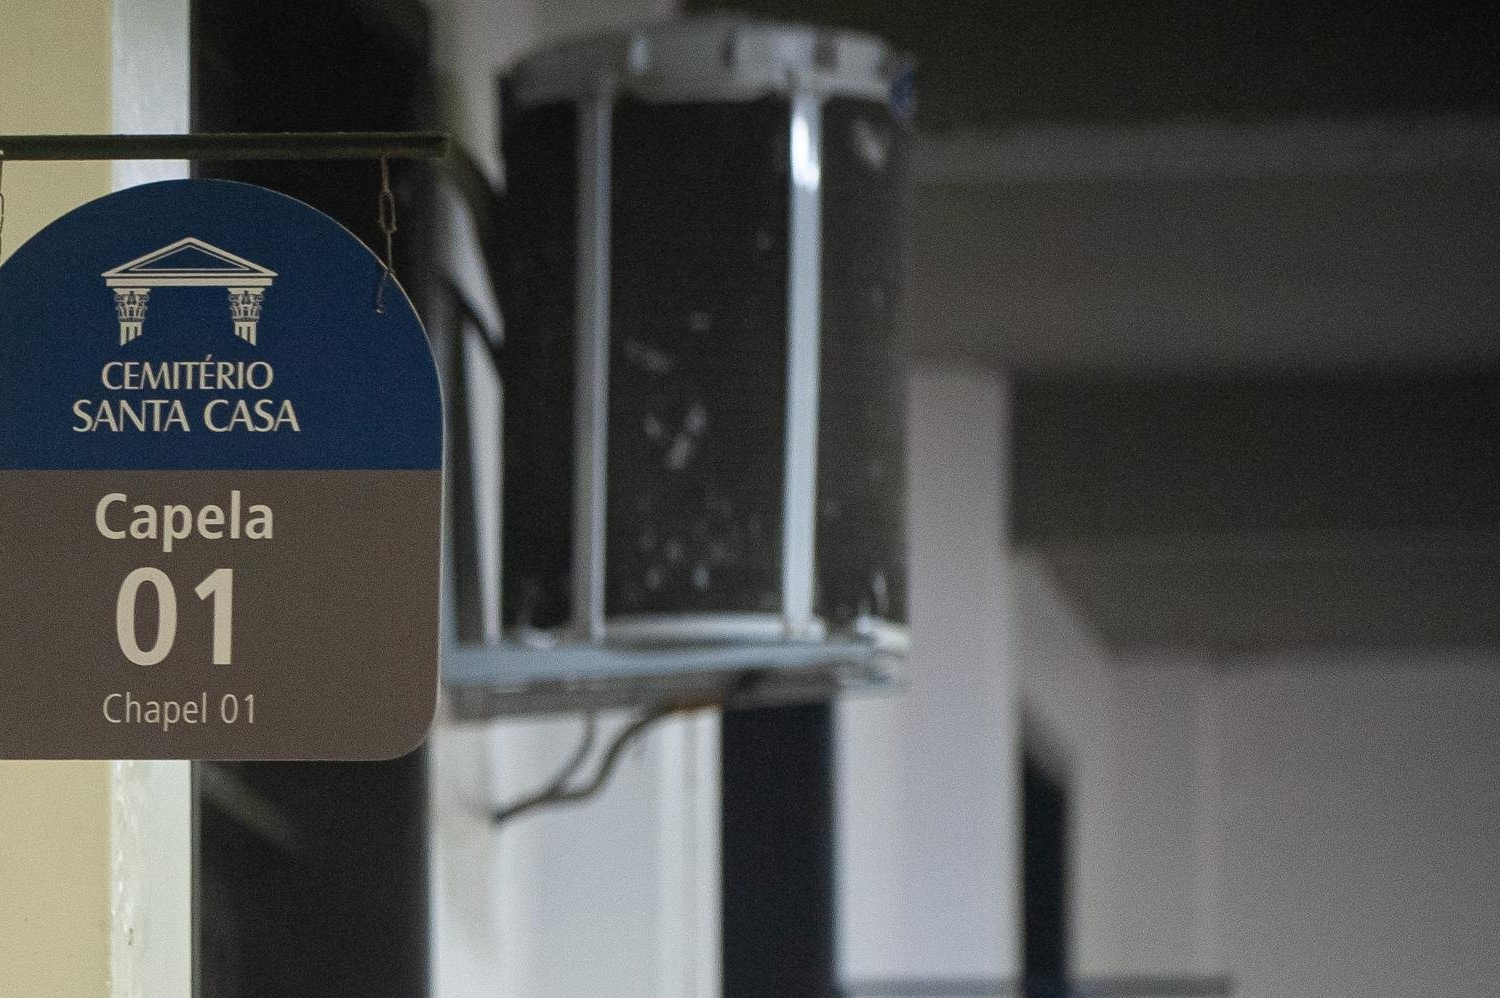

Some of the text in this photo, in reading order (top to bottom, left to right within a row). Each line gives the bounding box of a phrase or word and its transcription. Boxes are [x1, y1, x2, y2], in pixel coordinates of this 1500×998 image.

[102, 355, 274, 391] CEMITÉRIO
[72, 398, 301, 433] SANTA CASA
[95, 490, 274, 553] Capela
[116, 566, 235, 666] 01
[102, 692, 256, 732] Chapel 01
